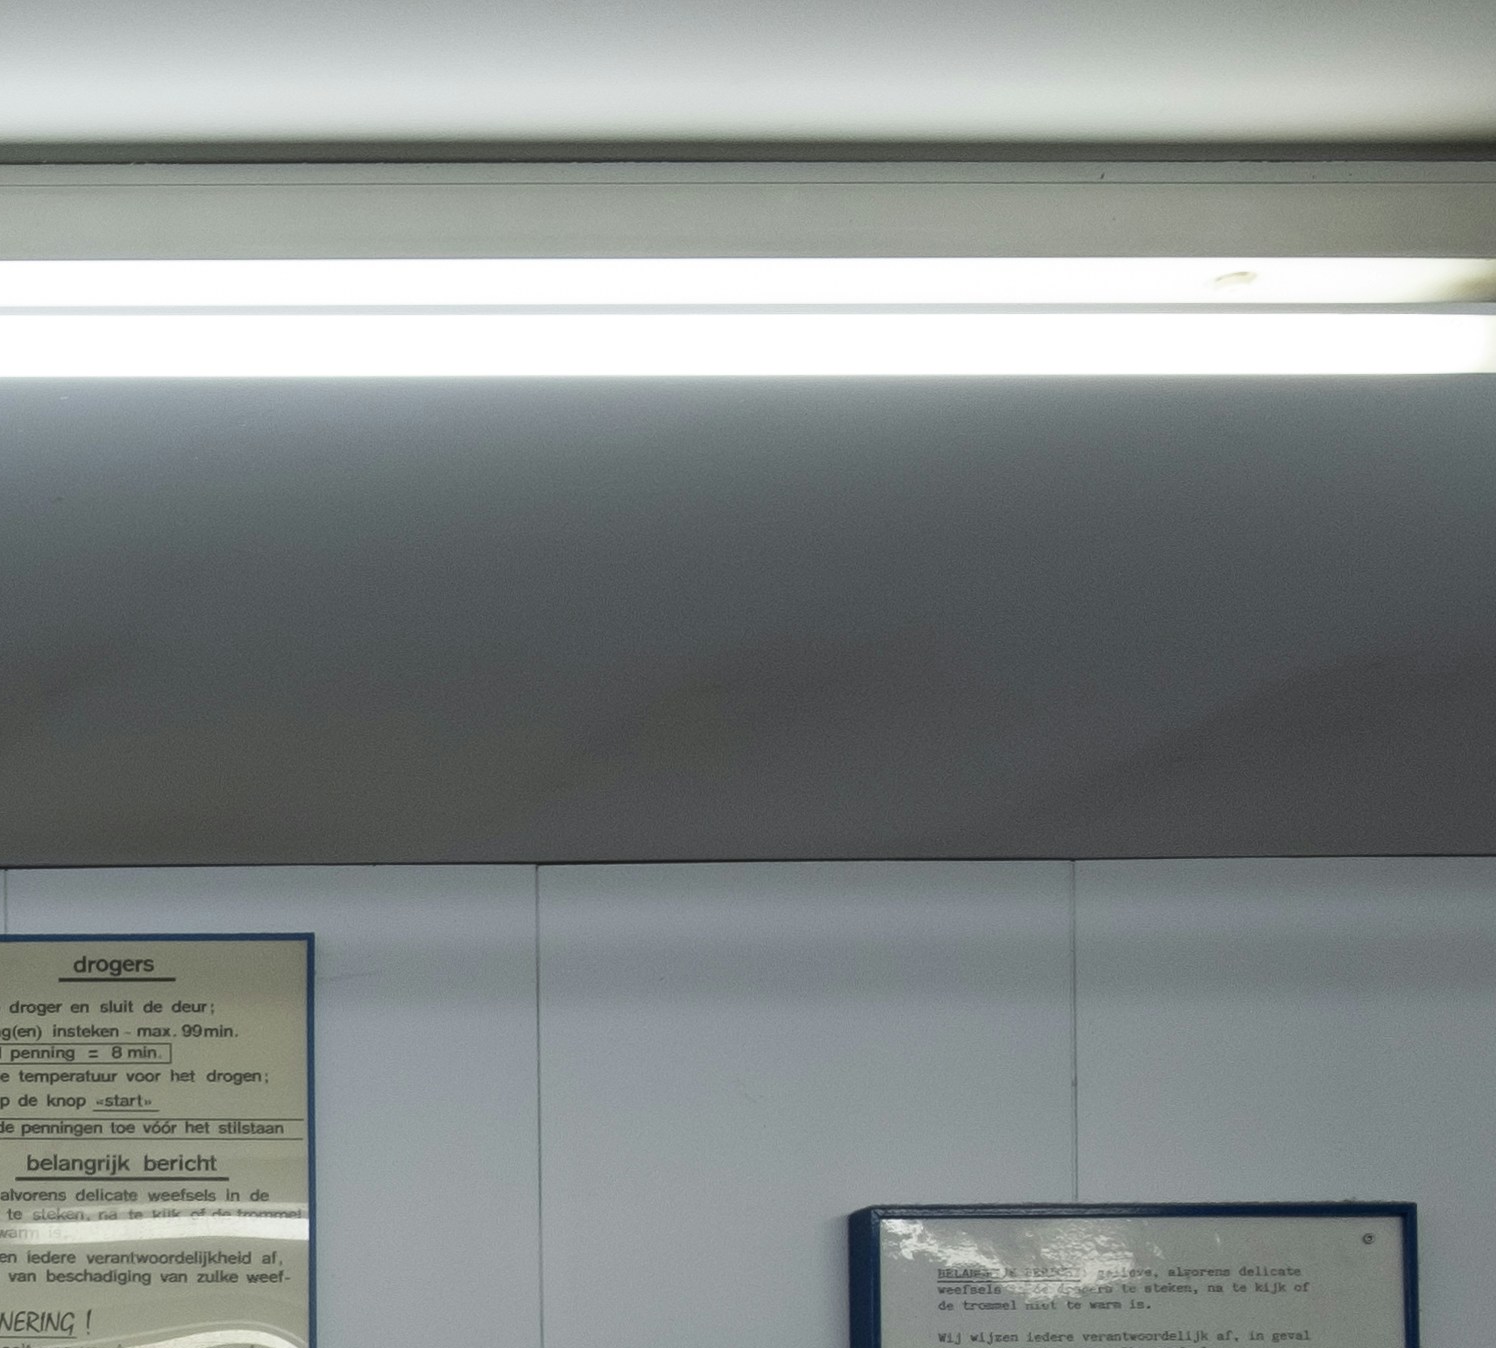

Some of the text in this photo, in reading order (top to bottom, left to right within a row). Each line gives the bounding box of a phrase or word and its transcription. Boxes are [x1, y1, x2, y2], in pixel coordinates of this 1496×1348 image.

[74, 955, 154, 975] drogers
[10, 1000, 63, 1017] droger
[70, 1003, 89, 1014] en
[100, 1000, 133, 1014] sluit
[143, 1000, 163, 1014] de
[19, 1070, 117, 1086] temperatuur
[126, 1072, 160, 1083] voor
[170, 1069, 195, 1083] het
[27, 1154, 217, 1176] belangrijk bericht
[9, 1270, 36, 1283] van
[46, 1269, 151, 1286] beschadiging
[160, 1271, 188, 1283] van
[197, 1269, 238, 1283] zulke
[246, 1269, 291, 1283] weef-
[938, 1331, 962, 1345] Wij
[970, 1331, 1020, 1346] wijzen
[1026, 1330, 1074, 1342] iedere
[1082, 1330, 1208, 1345] verantwoordelijk
[1248, 1330, 1264, 1341] in
[1271, 1330, 1311, 1344] geval
